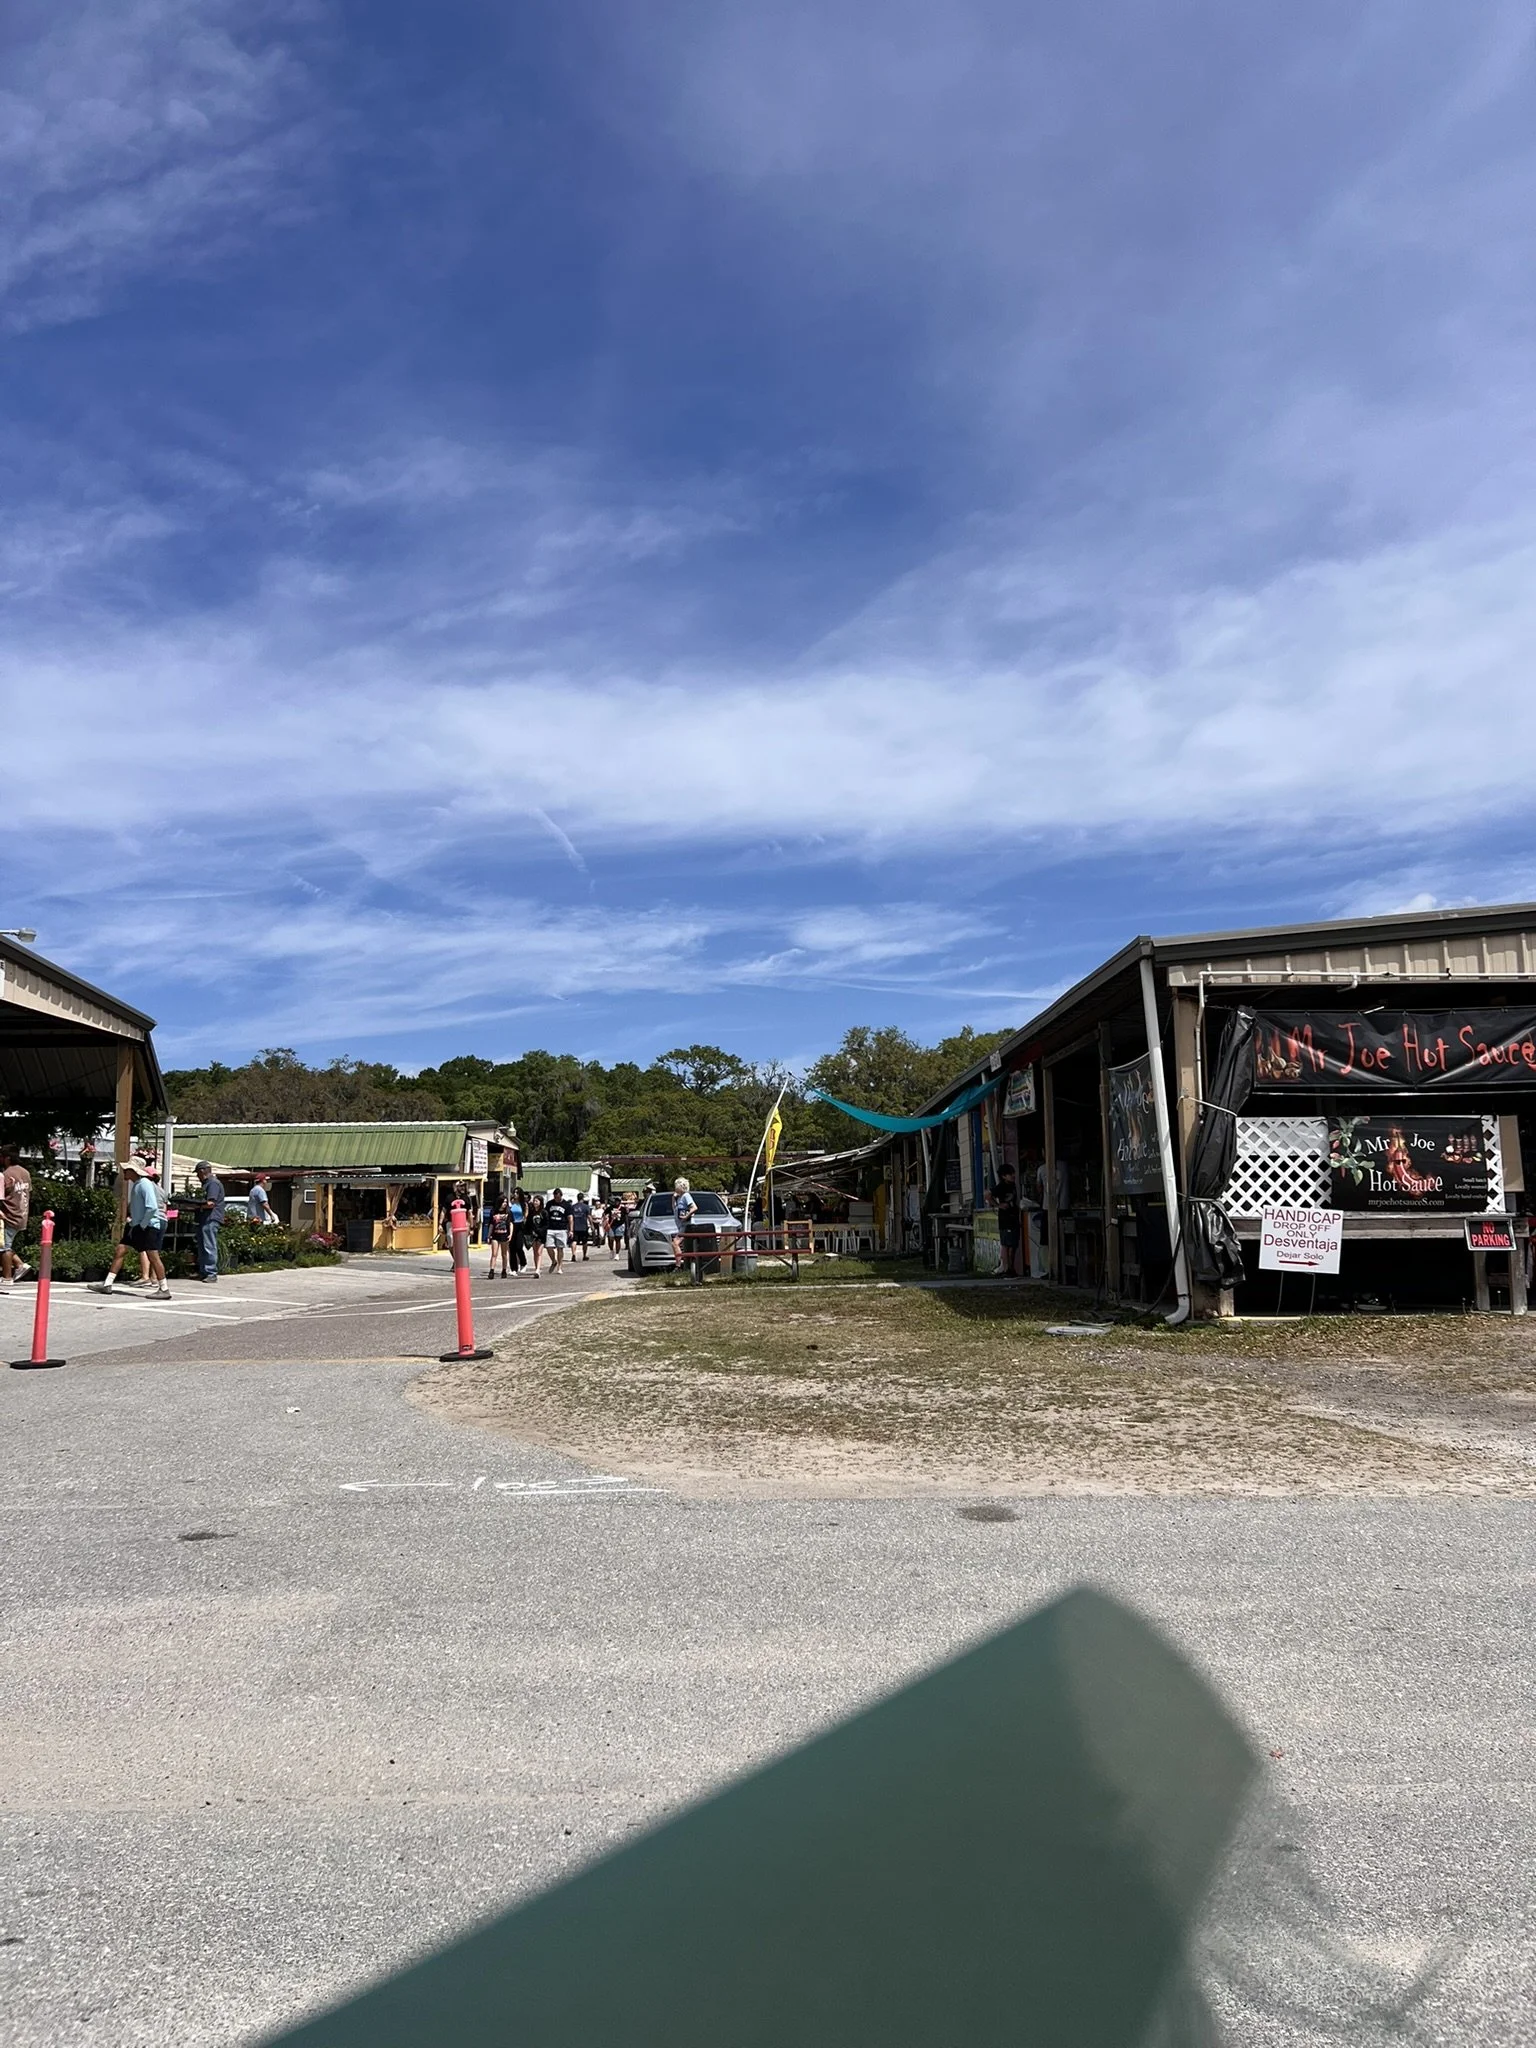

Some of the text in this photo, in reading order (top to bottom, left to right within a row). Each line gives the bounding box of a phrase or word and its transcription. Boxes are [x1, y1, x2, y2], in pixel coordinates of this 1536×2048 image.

[1289, 1023, 1328, 1073] Mr
[1338, 1022, 1393, 1074] Joe
[1402, 1023, 1450, 1072] Hot
[1364, 1133, 1436, 1154] Mr Joe
[1369, 1169, 1443, 1192] Hot Sauce
[1264, 1208, 1342, 1225] HANDICAP
[1273, 1221, 1332, 1232] DROP OFF
[1286, 1229, 1317, 1238] ONLY
[1482, 1221, 1495, 1234] NO
[1263, 1233, 1338, 1252] Desventaja
[1471, 1234, 1511, 1247] PARKING
[1276, 1250, 1325, 1260] Dejar Solo
